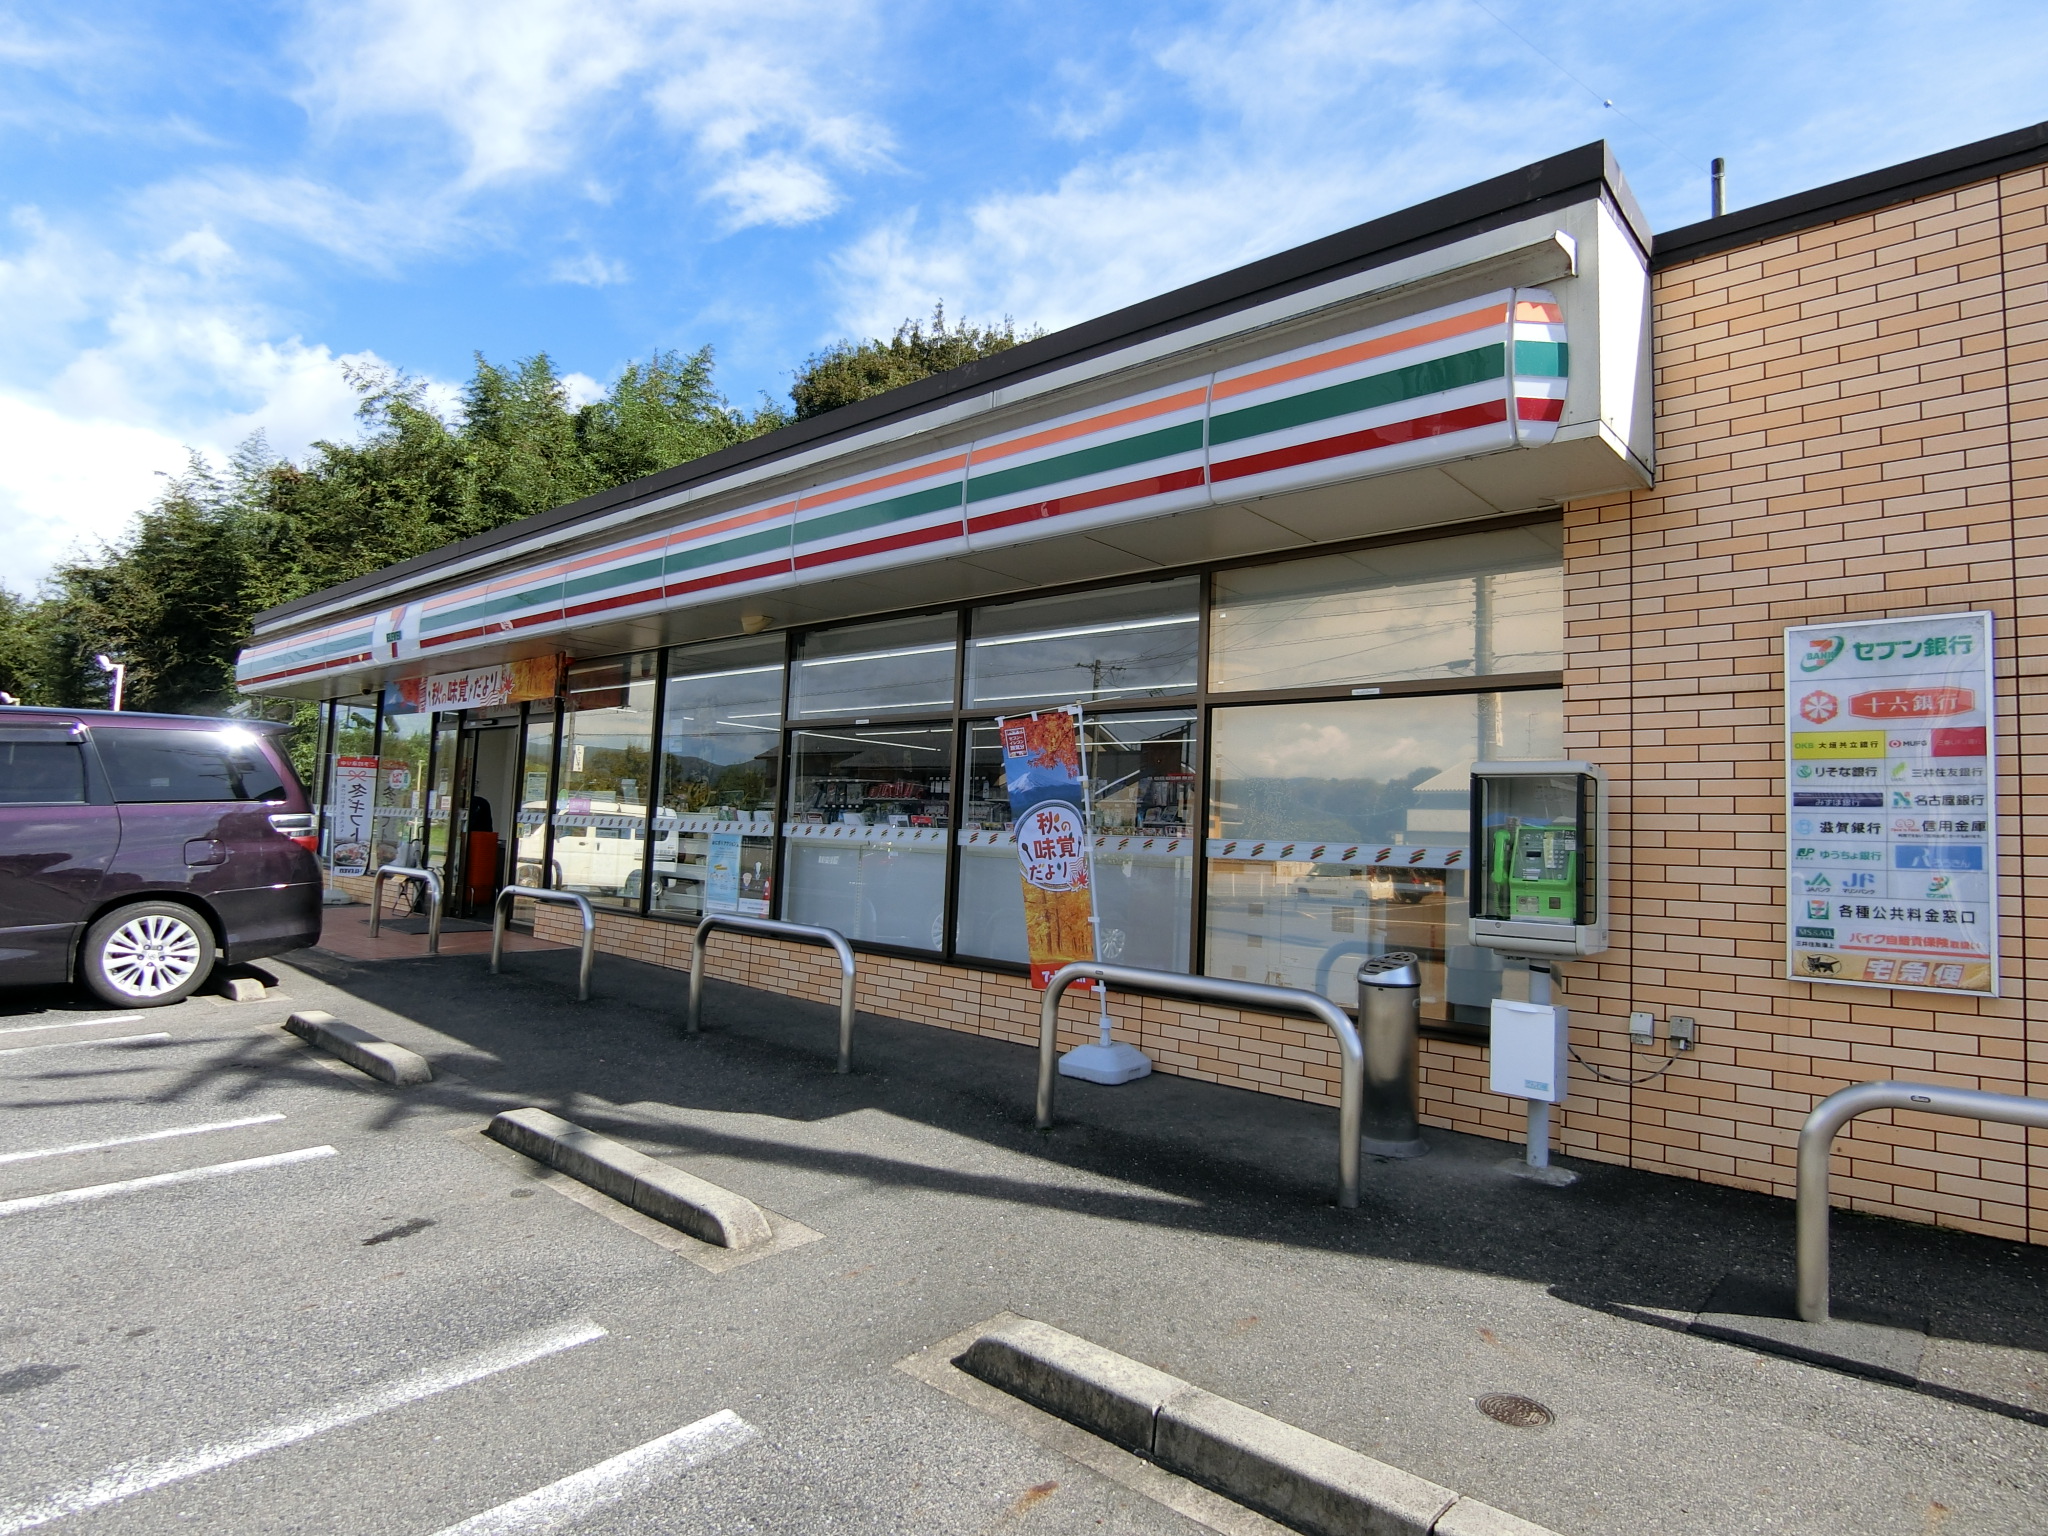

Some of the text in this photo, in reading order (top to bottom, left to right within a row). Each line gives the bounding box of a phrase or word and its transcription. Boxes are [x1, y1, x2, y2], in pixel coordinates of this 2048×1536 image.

[1853, 634, 1974, 661] セブン銀行
[1806, 651, 1835, 661] BANK
[431, 670, 498, 706] 秋の味覚だより
[1863, 694, 1959, 714] 十六銀行
[1795, 740, 1879, 750] OKB 大垣共立銀行
[1903, 739, 1927, 747] MUFG
[1815, 766, 1878, 778] りそな銀行
[1911, 767, 1983, 778] 三井住友銀行
[1815, 799, 1861, 807] みずほ銀行
[1914, 794, 1985, 807] 名古屋銀行
[1036, 811, 1071, 836] 秋の
[1819, 821, 1881, 835] 滋賀銀行
[1922, 820, 1987, 833] 信用金庫
[1033, 835, 1075, 860] 味覚
[1819, 850, 1882, 861] ゆうちょ銀行
[1029, 861, 1067, 882] だより
[1838, 904, 1976, 925] 各種公共料金窓口
[1864, 958, 1965, 987] 宅急便
